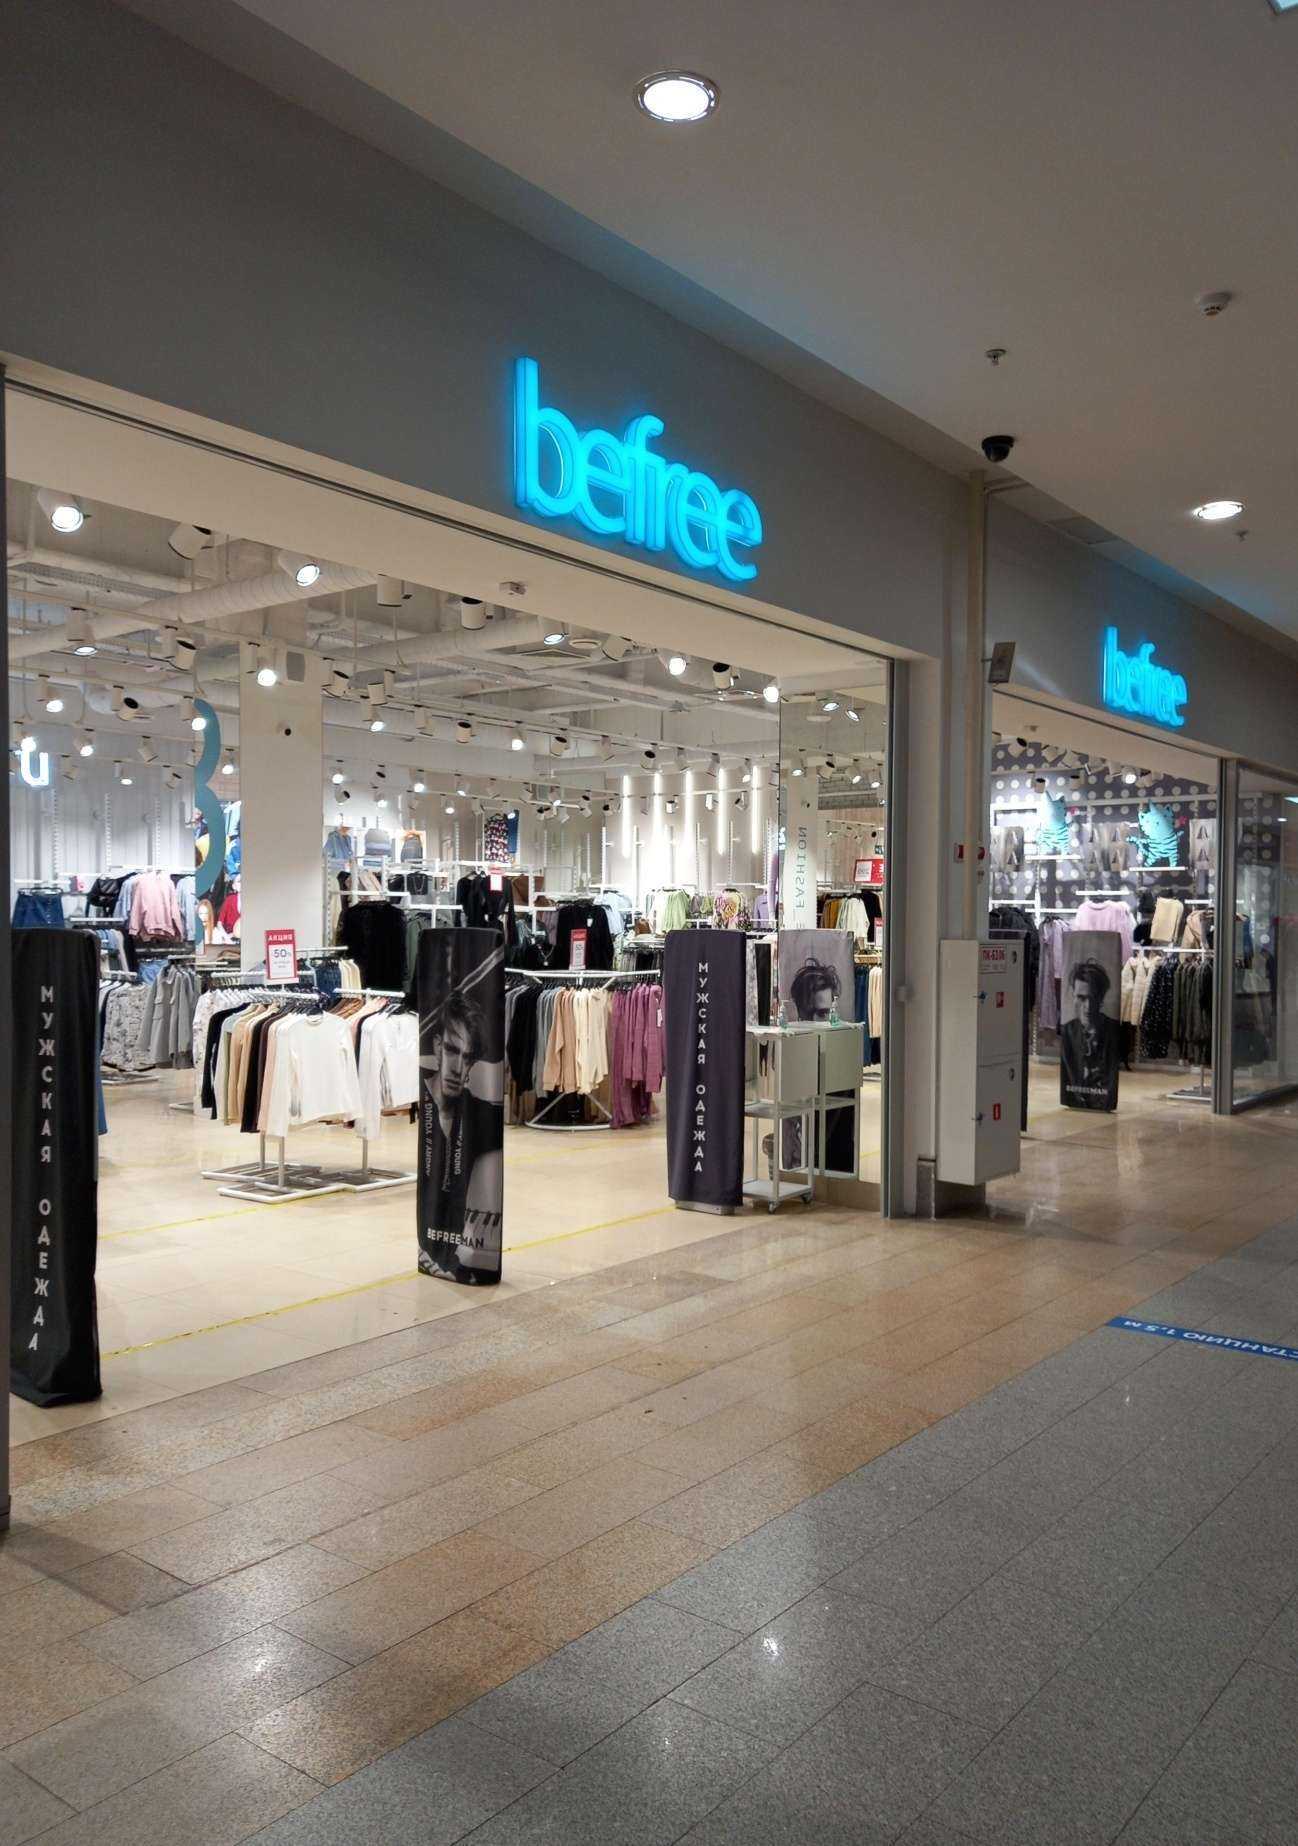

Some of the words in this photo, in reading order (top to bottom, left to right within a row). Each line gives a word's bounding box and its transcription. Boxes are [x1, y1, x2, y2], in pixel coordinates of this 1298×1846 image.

[514, 356, 763, 581] befree
[1103, 626, 1188, 726] befree
[696, 962, 709, 1064] МУЖСКАЯ
[38, 985, 55, 1164] МУЖСКАЯ
[425, 1103, 433, 1134] YOUNG
[692, 1084, 706, 1172] ОДЕЖДА
[28, 1198, 52, 1351] ОДЕЖДА
[427, 1227, 484, 1248] BEFREEMAN
